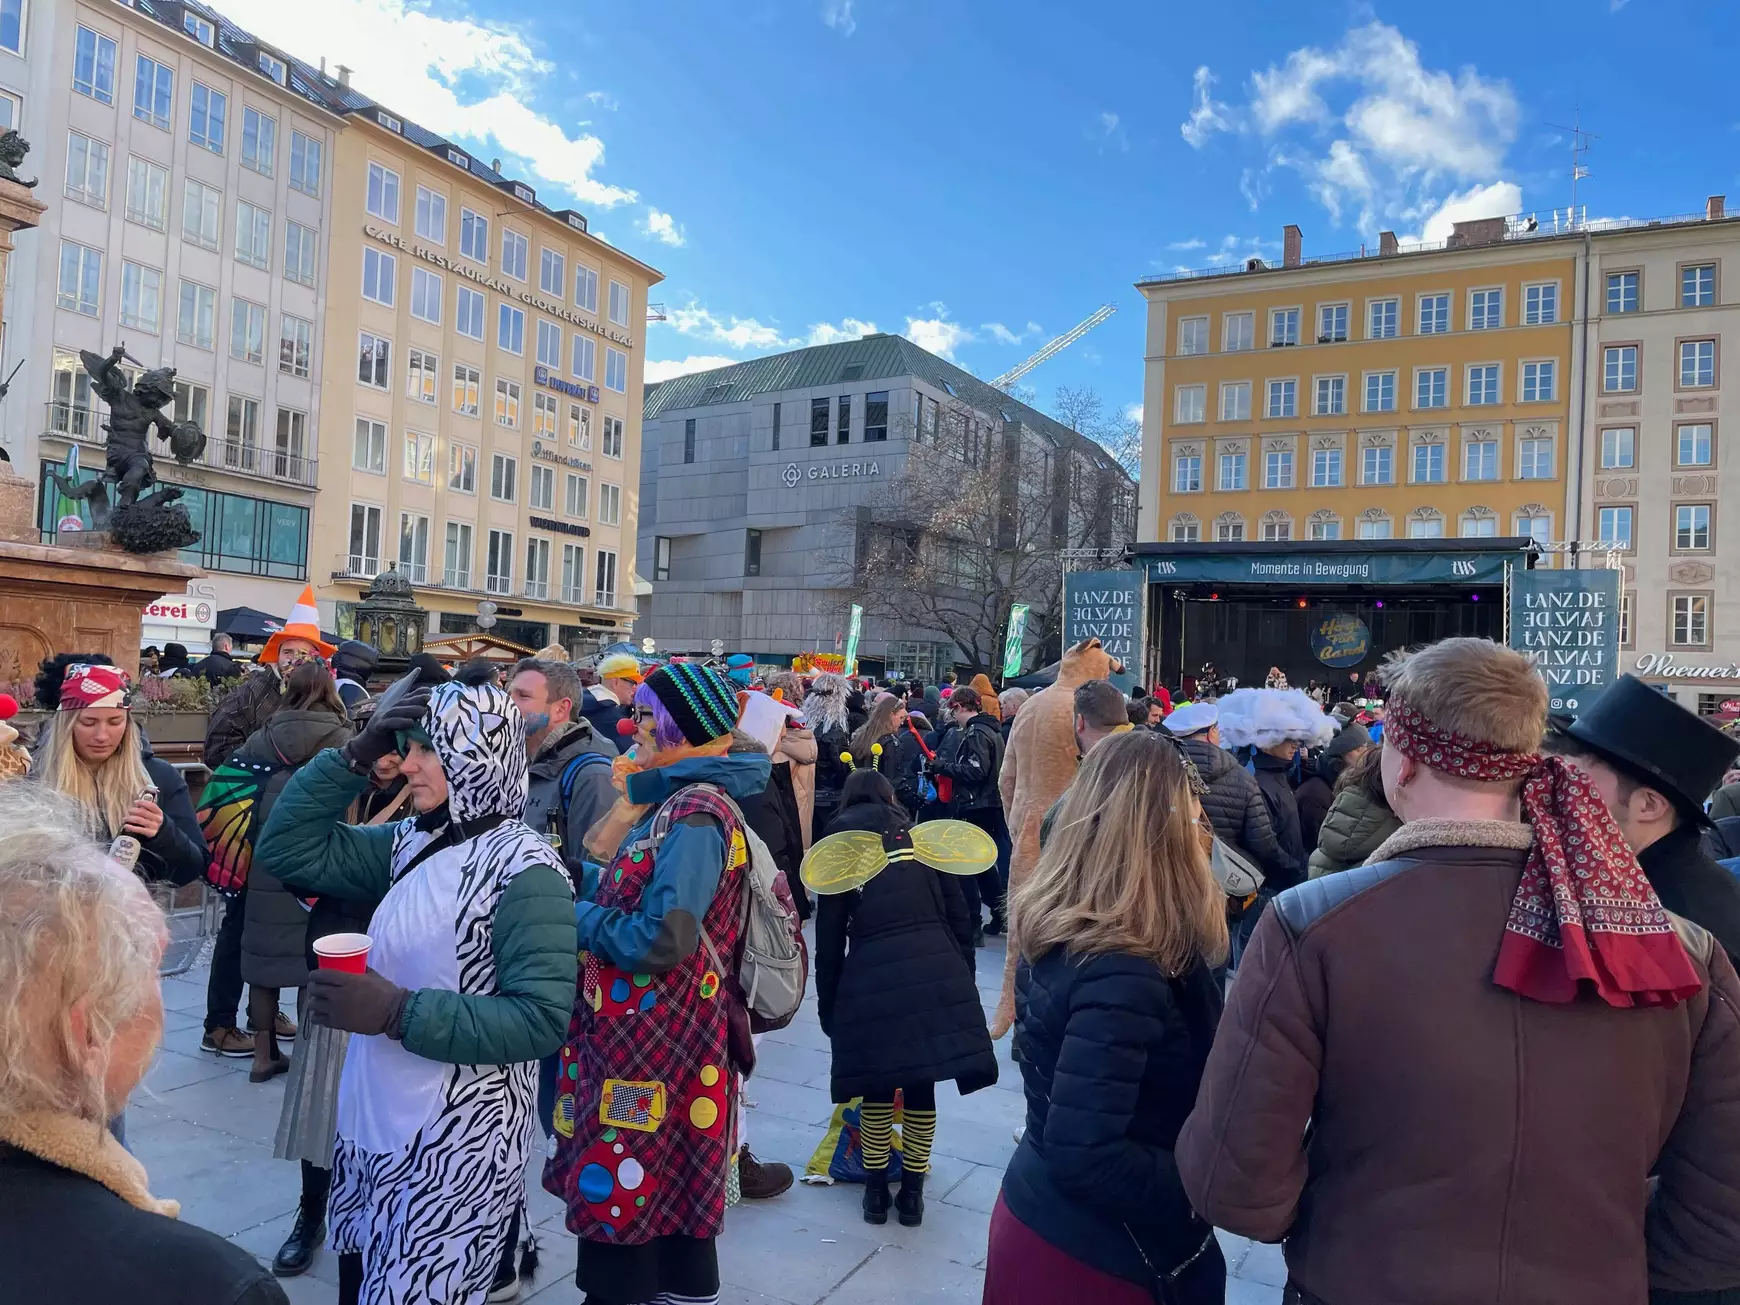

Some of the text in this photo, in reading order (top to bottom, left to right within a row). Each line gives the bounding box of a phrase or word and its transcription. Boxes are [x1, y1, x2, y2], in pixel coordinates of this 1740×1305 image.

[414, 245, 520, 298] RESTAURANT
[521, 291, 610, 338] GLOCKENSPIEL
[612, 331, 635, 349] BAR
[807, 462, 880, 480] GALERIA
[1251, 562, 1369, 578] Momente in Bewegung
